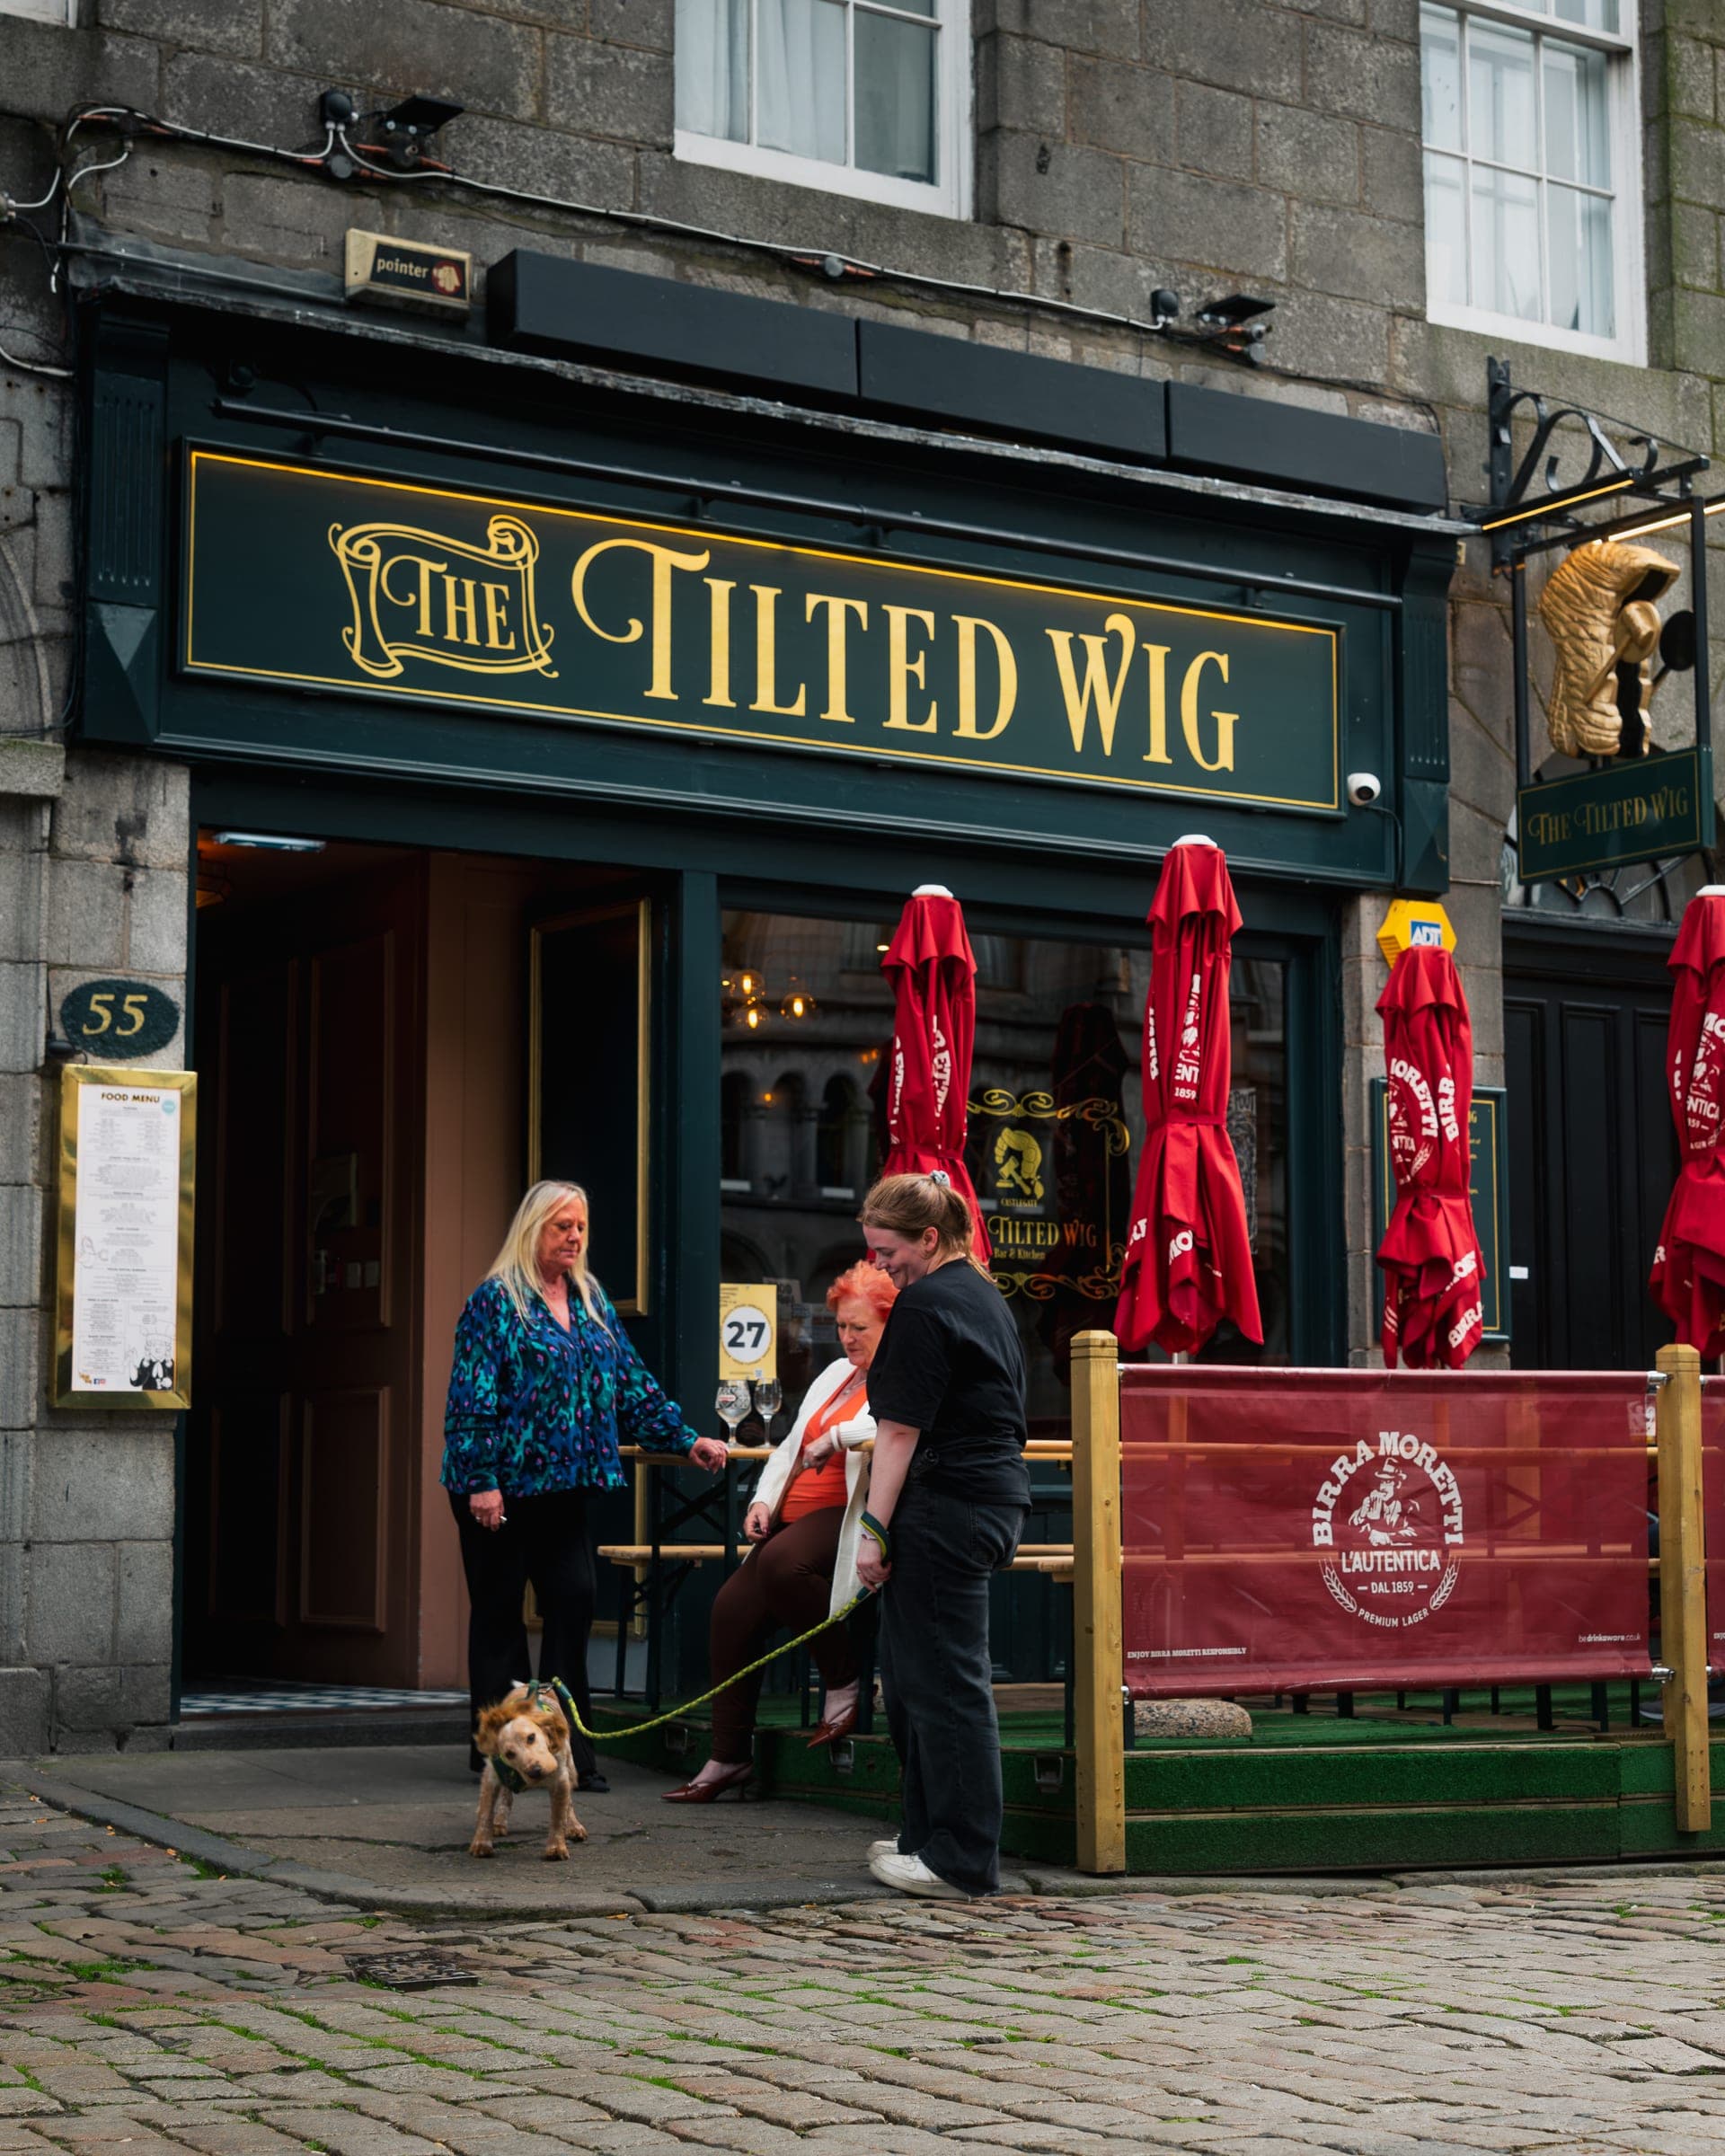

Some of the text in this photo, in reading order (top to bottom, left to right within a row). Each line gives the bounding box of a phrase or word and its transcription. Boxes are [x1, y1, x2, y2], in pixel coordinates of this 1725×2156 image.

[376, 258, 429, 278] pointer
[381, 538, 1240, 772] THE TILTED WIG
[1527, 785, 1689, 845] THE TILTED WIG
[1411, 925, 1442, 946] ADT
[82, 994, 148, 1036] 55
[101, 1092, 160, 1103] FOOD MENU
[987, 1215, 1059, 1247] TILTED
[1063, 1219, 1097, 1248] WIG
[727, 1321, 765, 1348] 27
[1312, 1431, 1464, 1546] BIRRA MORETTI
[1341, 1550, 1441, 1573] L'AUTENTICA
[1371, 1581, 1415, 1594] DAL 1859
[1358, 1608, 1429, 1628] PREMIUM LAGER
